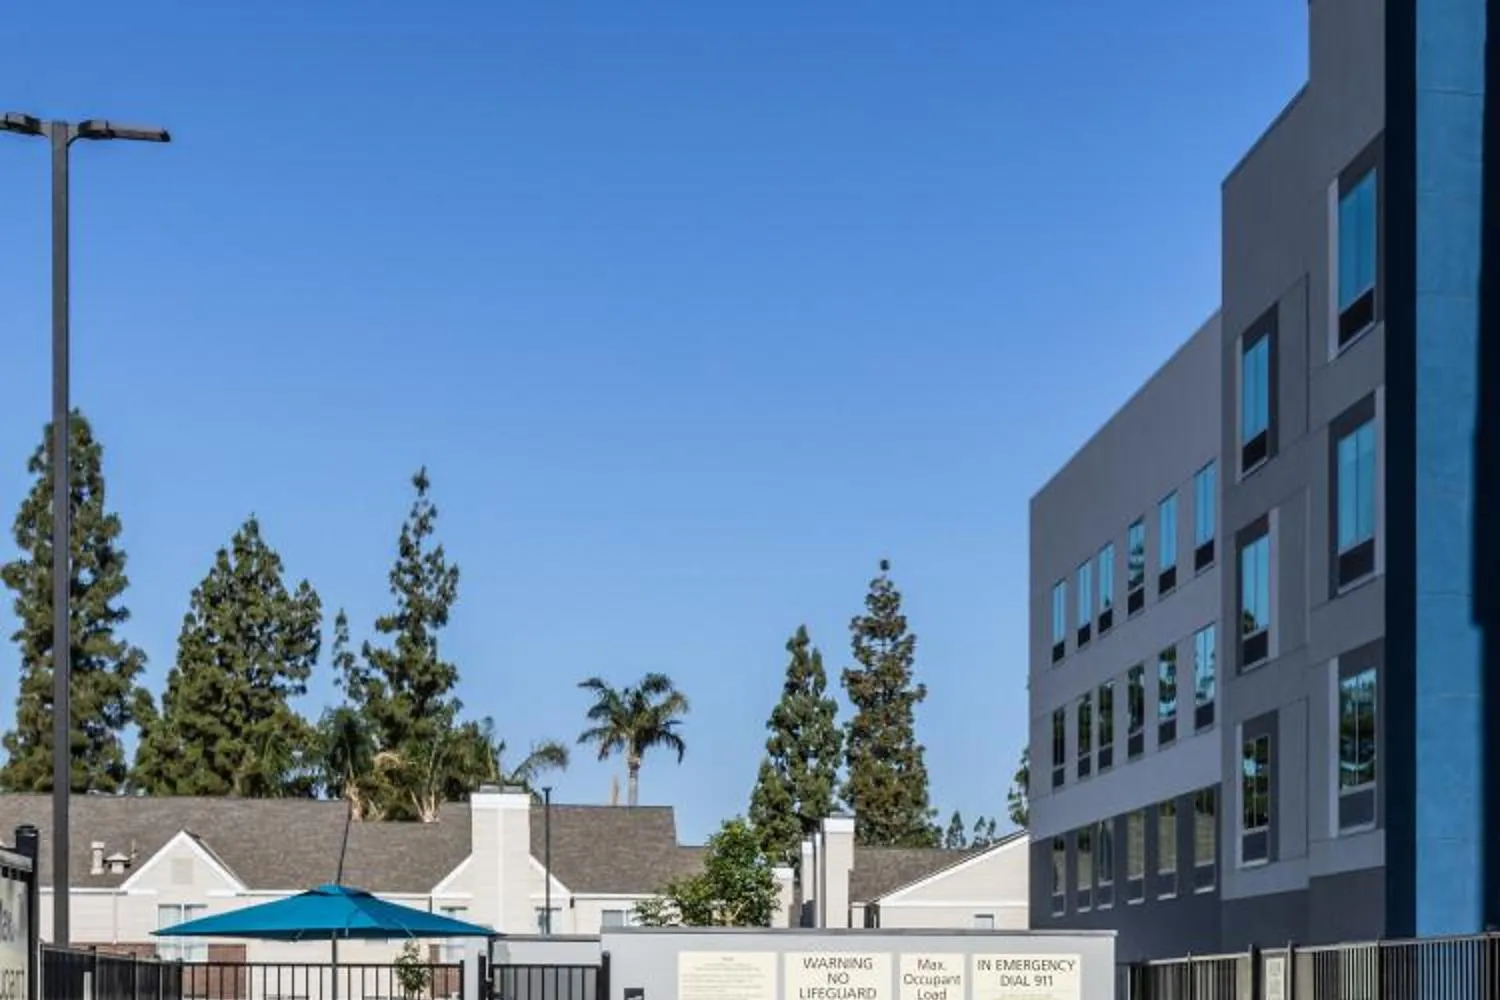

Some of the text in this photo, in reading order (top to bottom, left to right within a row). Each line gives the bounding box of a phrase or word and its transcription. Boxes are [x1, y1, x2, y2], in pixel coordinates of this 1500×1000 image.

[803, 957, 872, 970] WARNING
[977, 959, 1075, 972] IN EMERGENCY
[827, 972, 849, 985] NO
[903, 973, 961, 988] Occupant
[1000, 974, 1053, 987] DIAL 911
[799, 987, 877, 1000] LIFEGUARD
[917, 988, 947, 1000] Load
